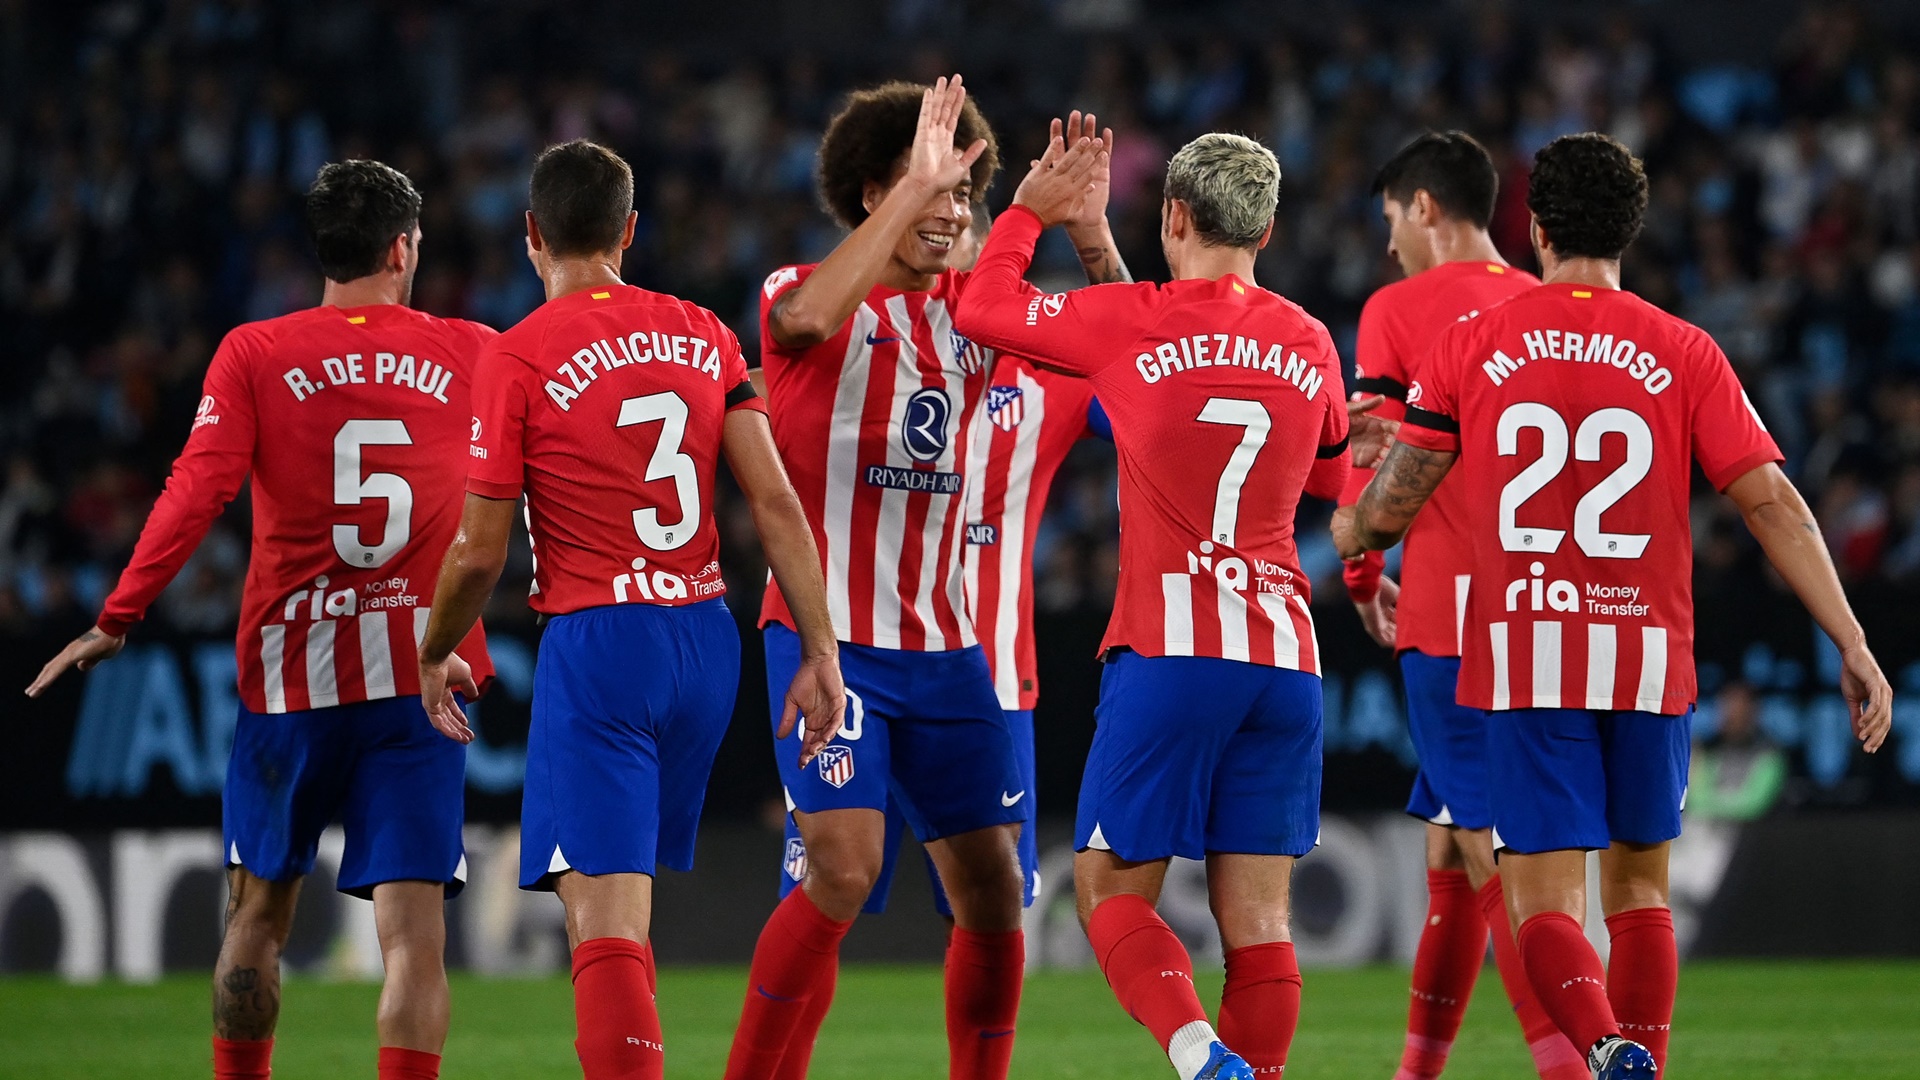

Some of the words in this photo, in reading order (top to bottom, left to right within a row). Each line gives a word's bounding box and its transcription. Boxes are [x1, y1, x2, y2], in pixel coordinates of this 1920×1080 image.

[282, 366, 325, 402] R.
[321, 353, 366, 386] DE
[375, 352, 453, 405] PAUL
[544, 331, 721, 412] AZPILICUETA
[1135, 333, 1324, 401] GRIEZMANN
[1481, 349, 1526, 387] M.
[1522, 329, 1673, 395] HERMOSO
[333, 419, 413, 569] 5
[615, 391, 700, 551] 3
[868, 466, 937, 491] RIYADH
[939, 475, 961, 492] AIR
[1196, 397, 1272, 549] 7
[1496, 402, 1653, 558] 22
[966, 525, 994, 544] AIR
[284, 574, 357, 621] ria
[360, 591, 419, 612] Transfer
[613, 556, 688, 604] ria
[1506, 561, 1580, 612] ria
[1585, 582, 1640, 601] Money
[1585, 600, 1650, 616] Transfer
